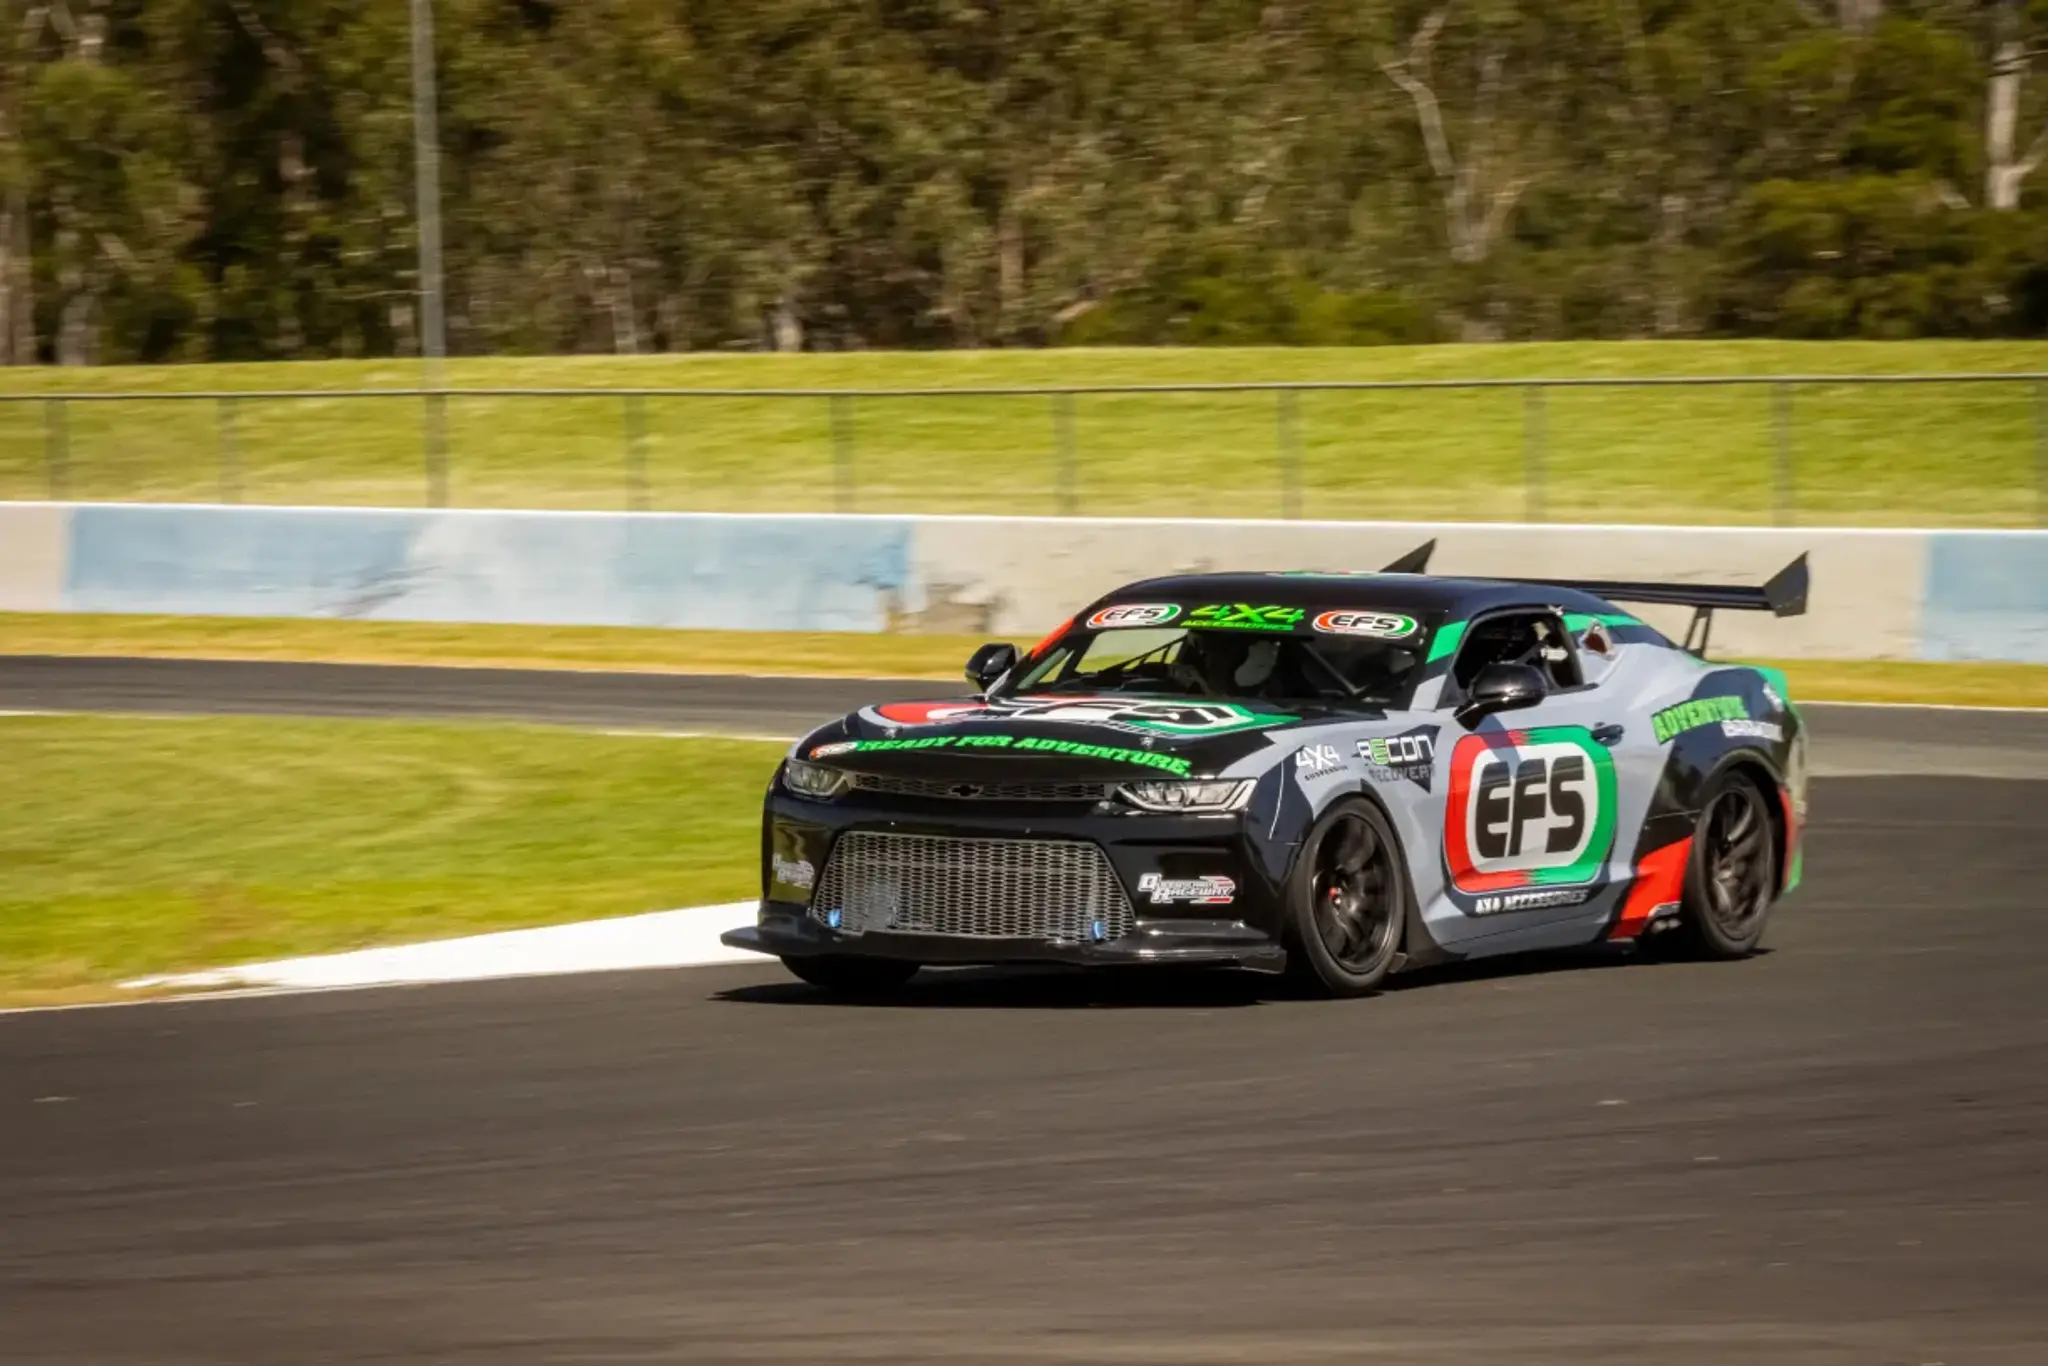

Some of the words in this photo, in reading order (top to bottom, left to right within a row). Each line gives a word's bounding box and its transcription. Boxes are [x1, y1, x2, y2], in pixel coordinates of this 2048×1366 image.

[1104, 607, 1165, 619] EFS
[1189, 603, 1305, 624] 4X4
[1331, 614, 1398, 630] EFS
[857, 736, 957, 751] READY
[953, 735, 1014, 747] FOR
[1356, 734, 1435, 766] RECON
[1295, 743, 1341, 770] 4X4
[1475, 755, 1585, 858] EFS
